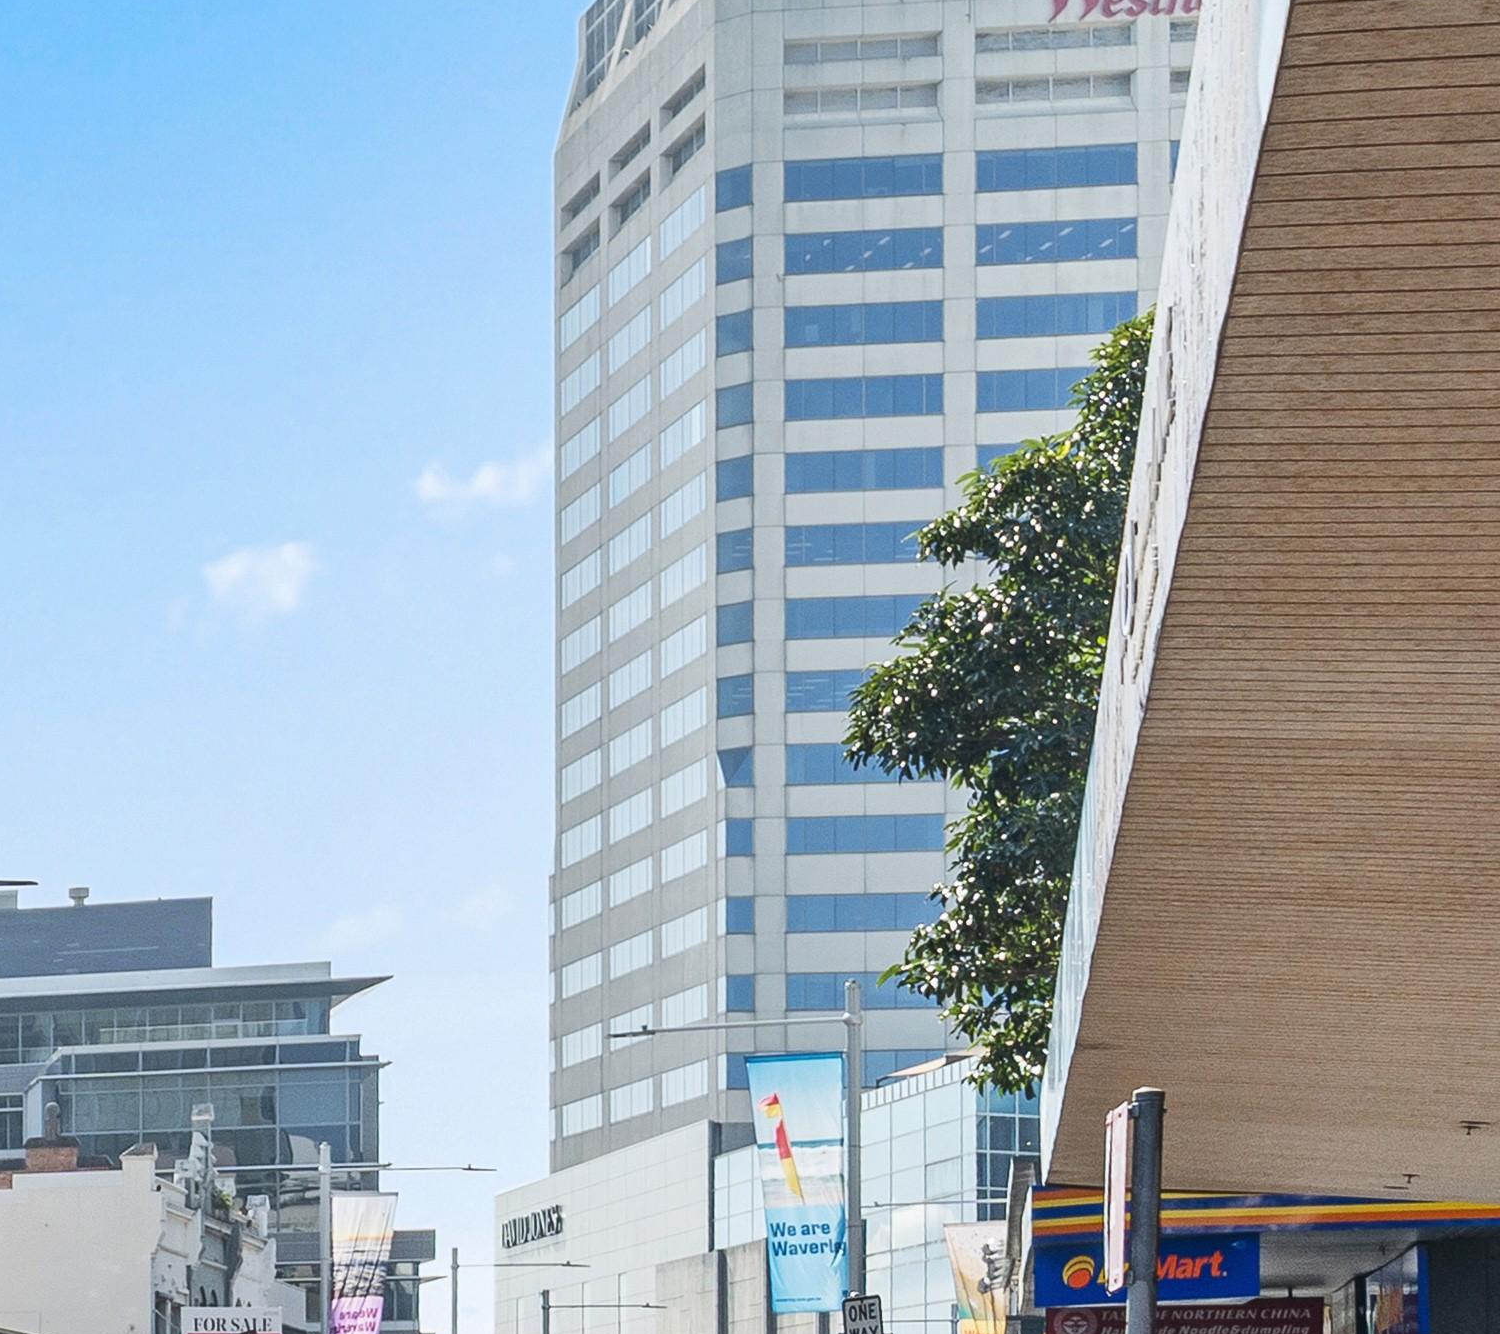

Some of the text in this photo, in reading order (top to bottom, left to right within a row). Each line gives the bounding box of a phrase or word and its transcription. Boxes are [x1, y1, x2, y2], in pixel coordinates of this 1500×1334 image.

[770, 1222, 831, 1237] We are
[848, 1302, 877, 1322] ONE
[1172, 1309, 1258, 1320] NORTHERN
[1260, 1308, 1312, 1319] CHINA
[194, 1317, 273, 1332] FOR SALE
